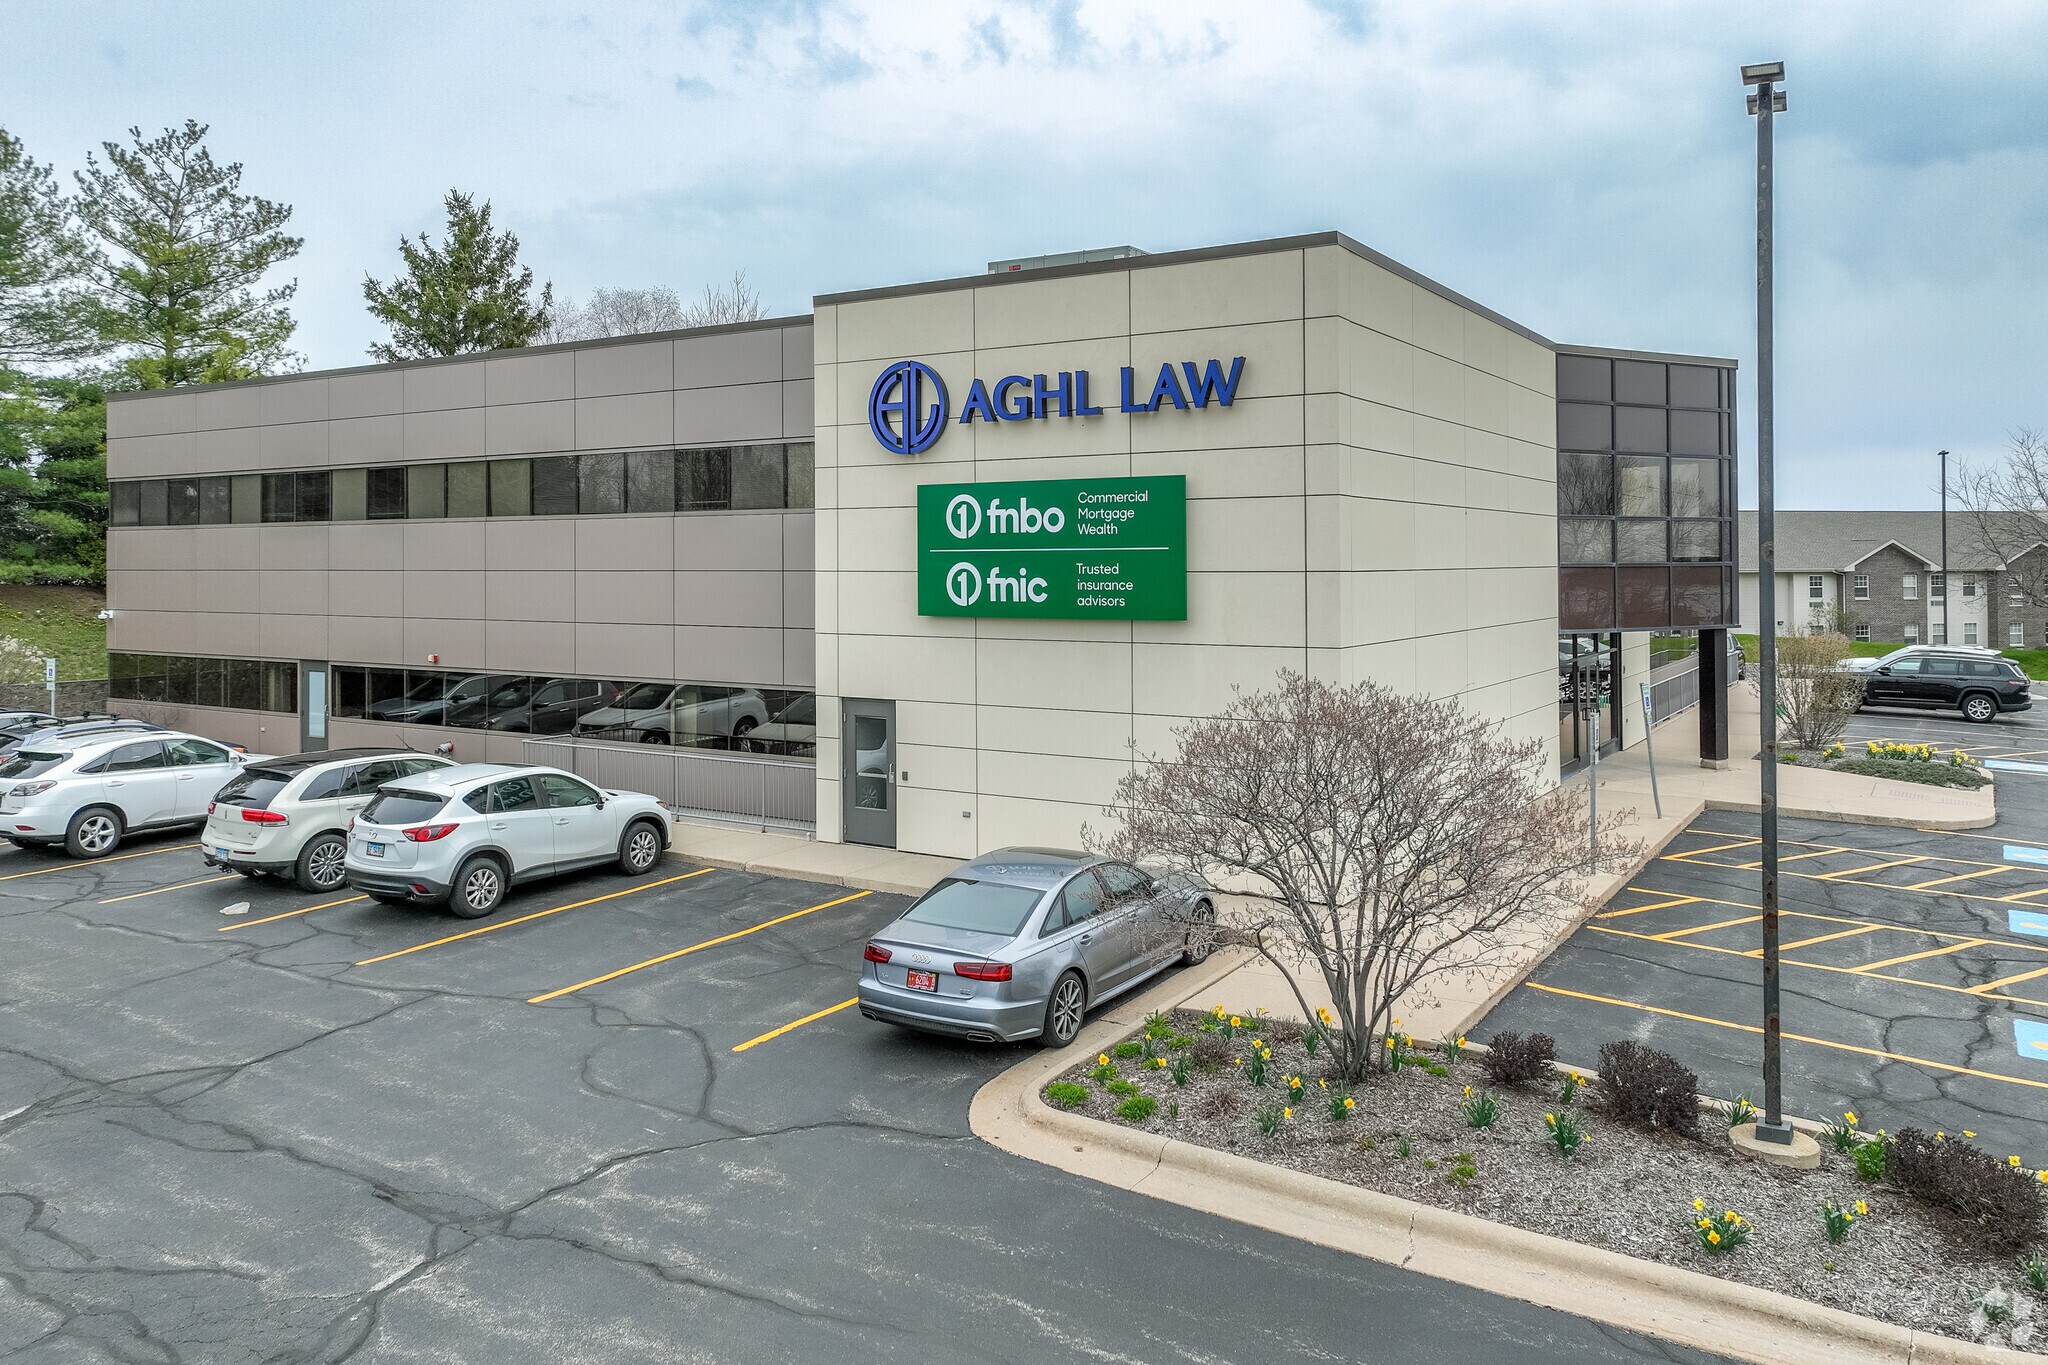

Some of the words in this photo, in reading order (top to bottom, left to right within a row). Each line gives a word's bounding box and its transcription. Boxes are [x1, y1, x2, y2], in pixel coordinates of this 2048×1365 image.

[959, 369, 1104, 424] AGHL
[1120, 356, 1247, 413] LAW
[1077, 490, 1149, 504] Commercial
[986, 497, 1066, 534] fnbo
[1077, 507, 1135, 523] Mortgage
[1077, 523, 1119, 536] Wealth
[1076, 562, 1120, 575] Trusted
[986, 567, 1049, 603] fnic
[1076, 579, 1134, 592] insurance
[1076, 594, 1126, 607] advisors
